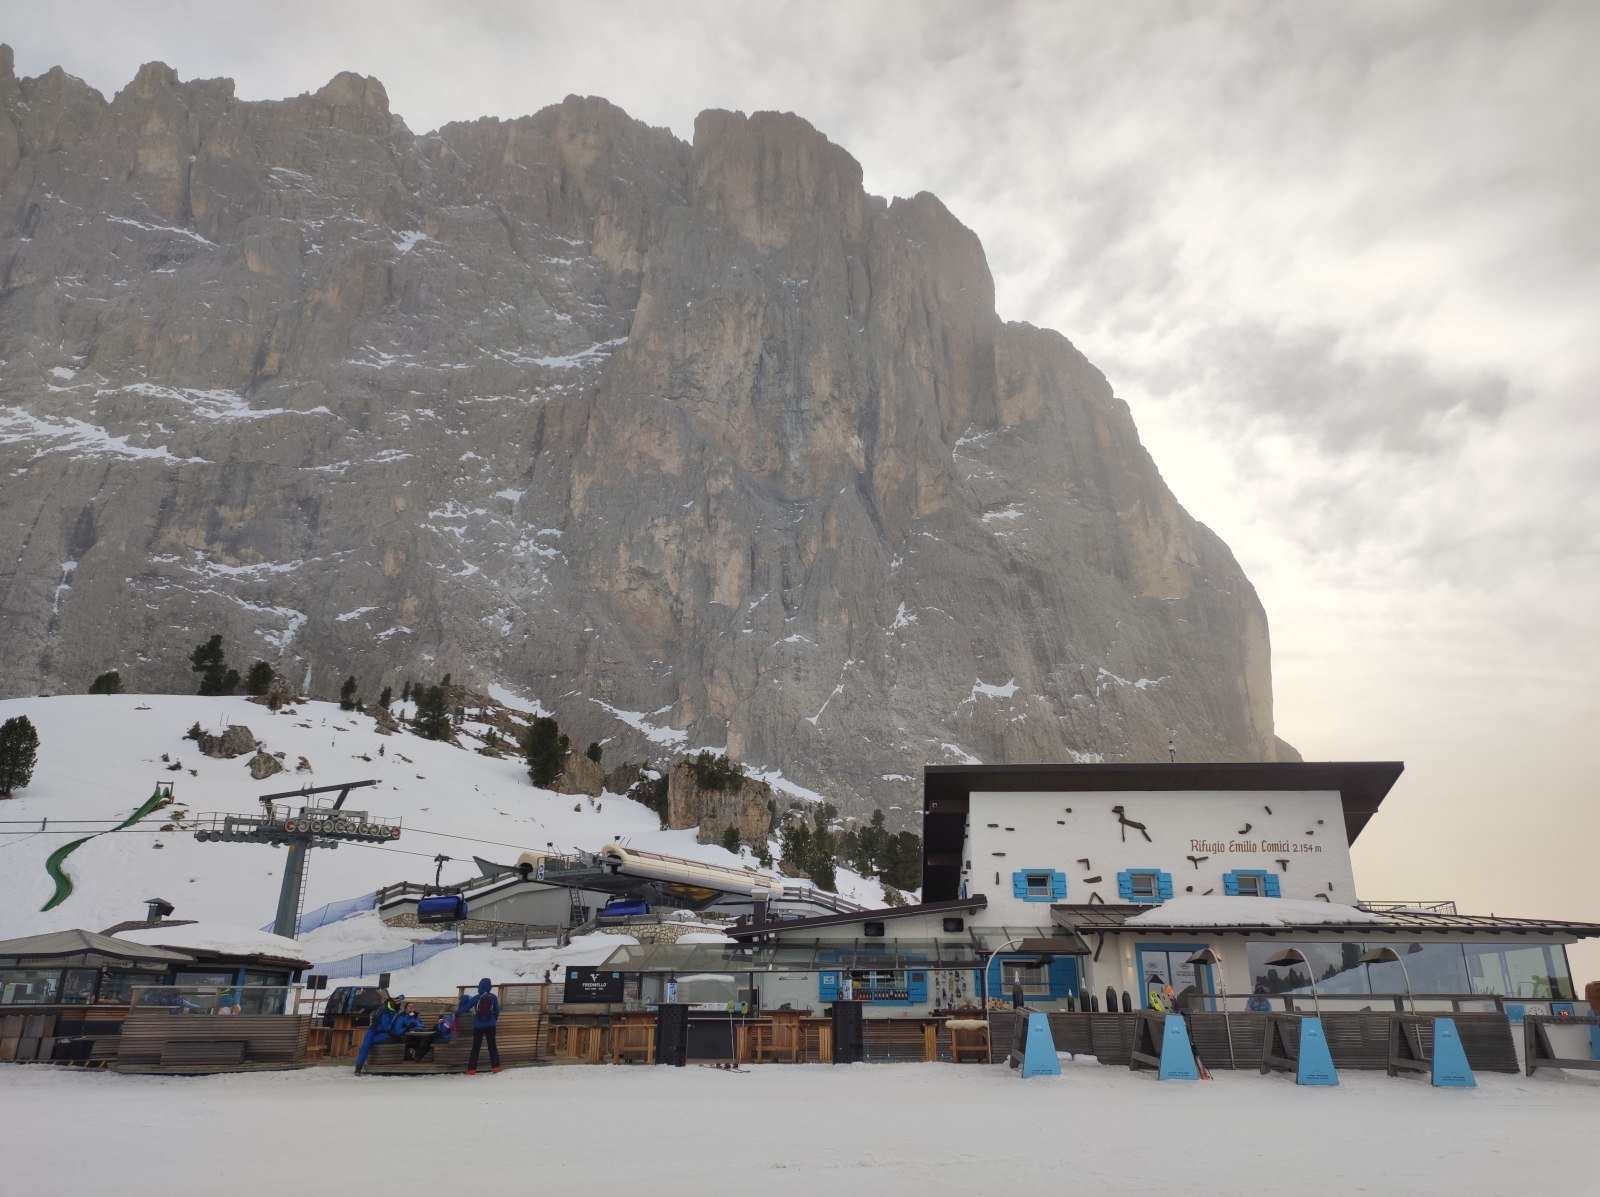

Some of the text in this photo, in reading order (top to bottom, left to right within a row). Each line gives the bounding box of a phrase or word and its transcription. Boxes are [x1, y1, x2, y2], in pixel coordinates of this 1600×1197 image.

[1190, 839, 1322, 854] Rifugio Emilio Comici 2.154 m
